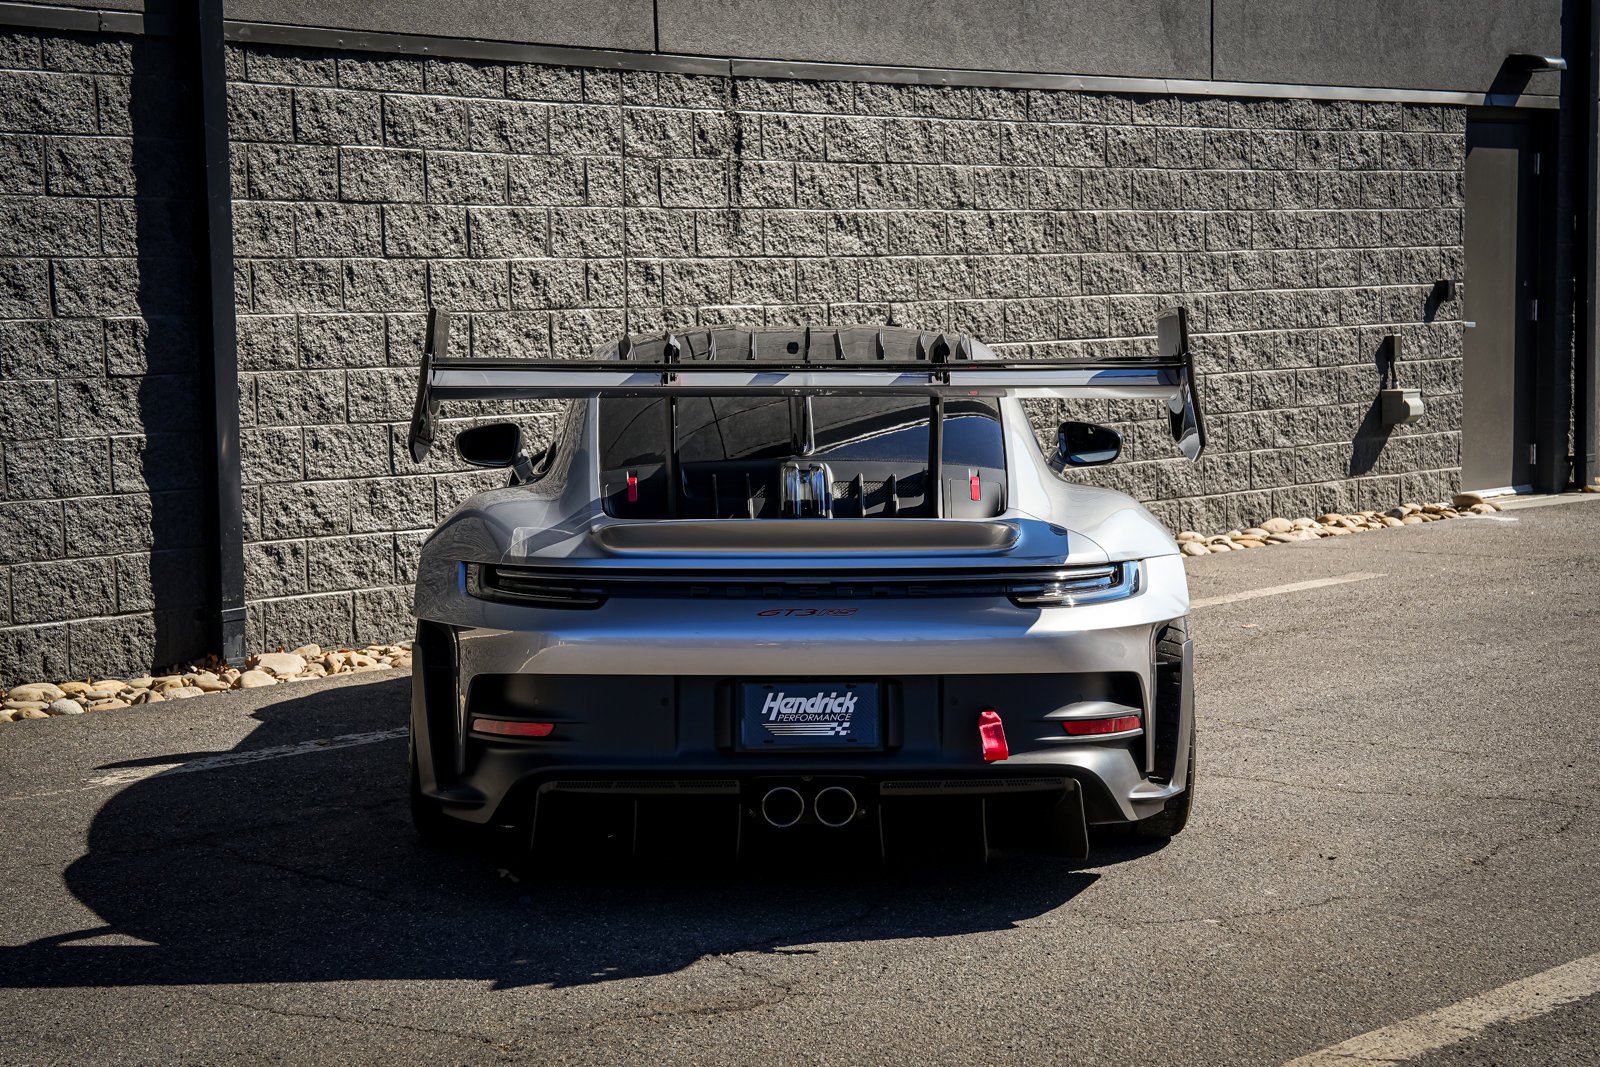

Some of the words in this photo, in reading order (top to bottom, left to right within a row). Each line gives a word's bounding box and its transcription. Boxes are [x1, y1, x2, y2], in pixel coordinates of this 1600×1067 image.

[689, 585, 929, 598] PORSCHE
[761, 691, 858, 721] Hendrick
[777, 713, 853, 722] PERFORMANCE
